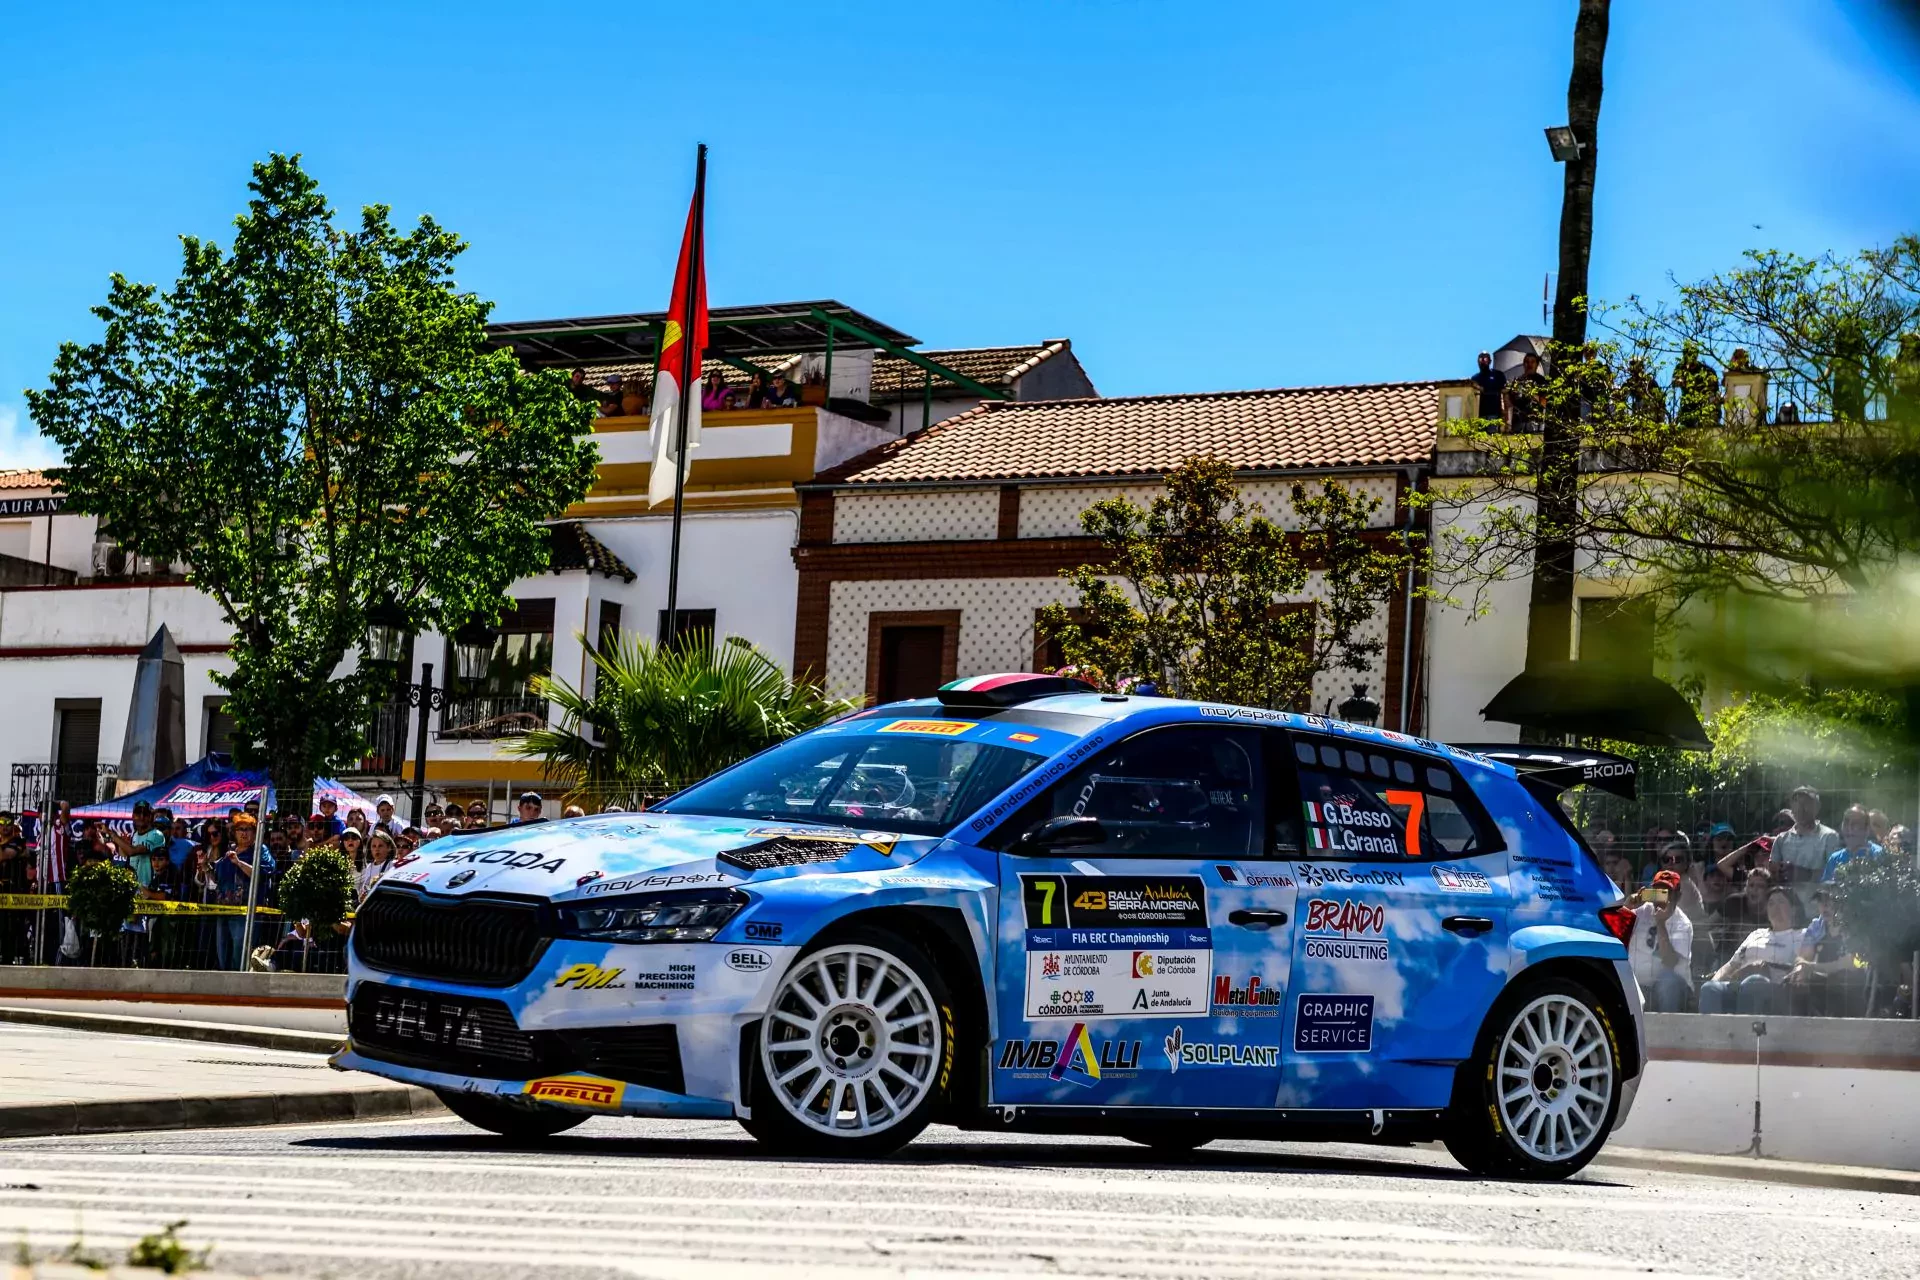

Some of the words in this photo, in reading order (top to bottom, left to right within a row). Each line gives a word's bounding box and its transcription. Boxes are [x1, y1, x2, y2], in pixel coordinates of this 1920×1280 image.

[0, 499, 66, 514] AURAN
[1201, 707, 1290, 723] movisport
[892, 721, 964, 734] PIRELLI
[1414, 737, 1438, 750] OMP
[971, 735, 1104, 833] @giandomenico_basso
[1323, 802, 1392, 828] G.Basso
[1385, 788, 1424, 855] 7
[1328, 828, 1399, 854] L.Granai
[431, 850, 567, 874] SKODA
[586, 873, 728, 895] movisport
[1246, 876, 1295, 888] OPTIMA
[1321, 867, 1406, 887] BIGonDRY
[1460, 879, 1491, 889] TOUCH
[1035, 881, 1056, 925] 7
[1073, 891, 1107, 910] 43
[1108, 890, 1144, 901] RALLY
[1108, 901, 1149, 911] SIERRA
[1150, 901, 1200, 911] MORENA
[1137, 912, 1167, 920] CÓRDOBA
[1305, 900, 1385, 938] BRANDO
[745, 924, 783, 939] OMP
[1072, 933, 1087, 944] FIA
[1090, 933, 1107, 944] ERC
[1109, 932, 1170, 946] Championship
[731, 953, 769, 965] BELL
[1306, 943, 1388, 960] CONSULTING
[1064, 954, 1108, 965] AYUNTAMIENTO
[1157, 955, 1196, 966] Diputación
[668, 964, 696, 972] HIGH
[1064, 966, 1072, 975] DE
[1072, 965, 1100, 975] CÓRDOBA
[1157, 966, 1165, 975] de
[1168, 965, 1196, 975] Córdoba
[554, 963, 626, 990] PM
[634, 982, 695, 990] MACHINING
[1213, 975, 1280, 1006] MetalColbe
[1151, 990, 1170, 998] Junta
[1038, 1004, 1078, 1015] CÓRDOBA
[1151, 999, 1159, 1007] de
[1160, 997, 1192, 1006] Andalucía
[941, 1005, 953, 1023] P
[1213, 1009, 1240, 1018] Building
[1303, 1003, 1369, 1017] GRAPHIC
[375, 998, 484, 1049] DELTA
[1300, 1029, 1367, 1043] SERVICE
[940, 1023, 955, 1089] ZERO
[998, 1023, 1142, 1082] IMBALLI
[1182, 1044, 1279, 1066] SOLPLANT
[529, 1081, 616, 1104] PIRELLI
